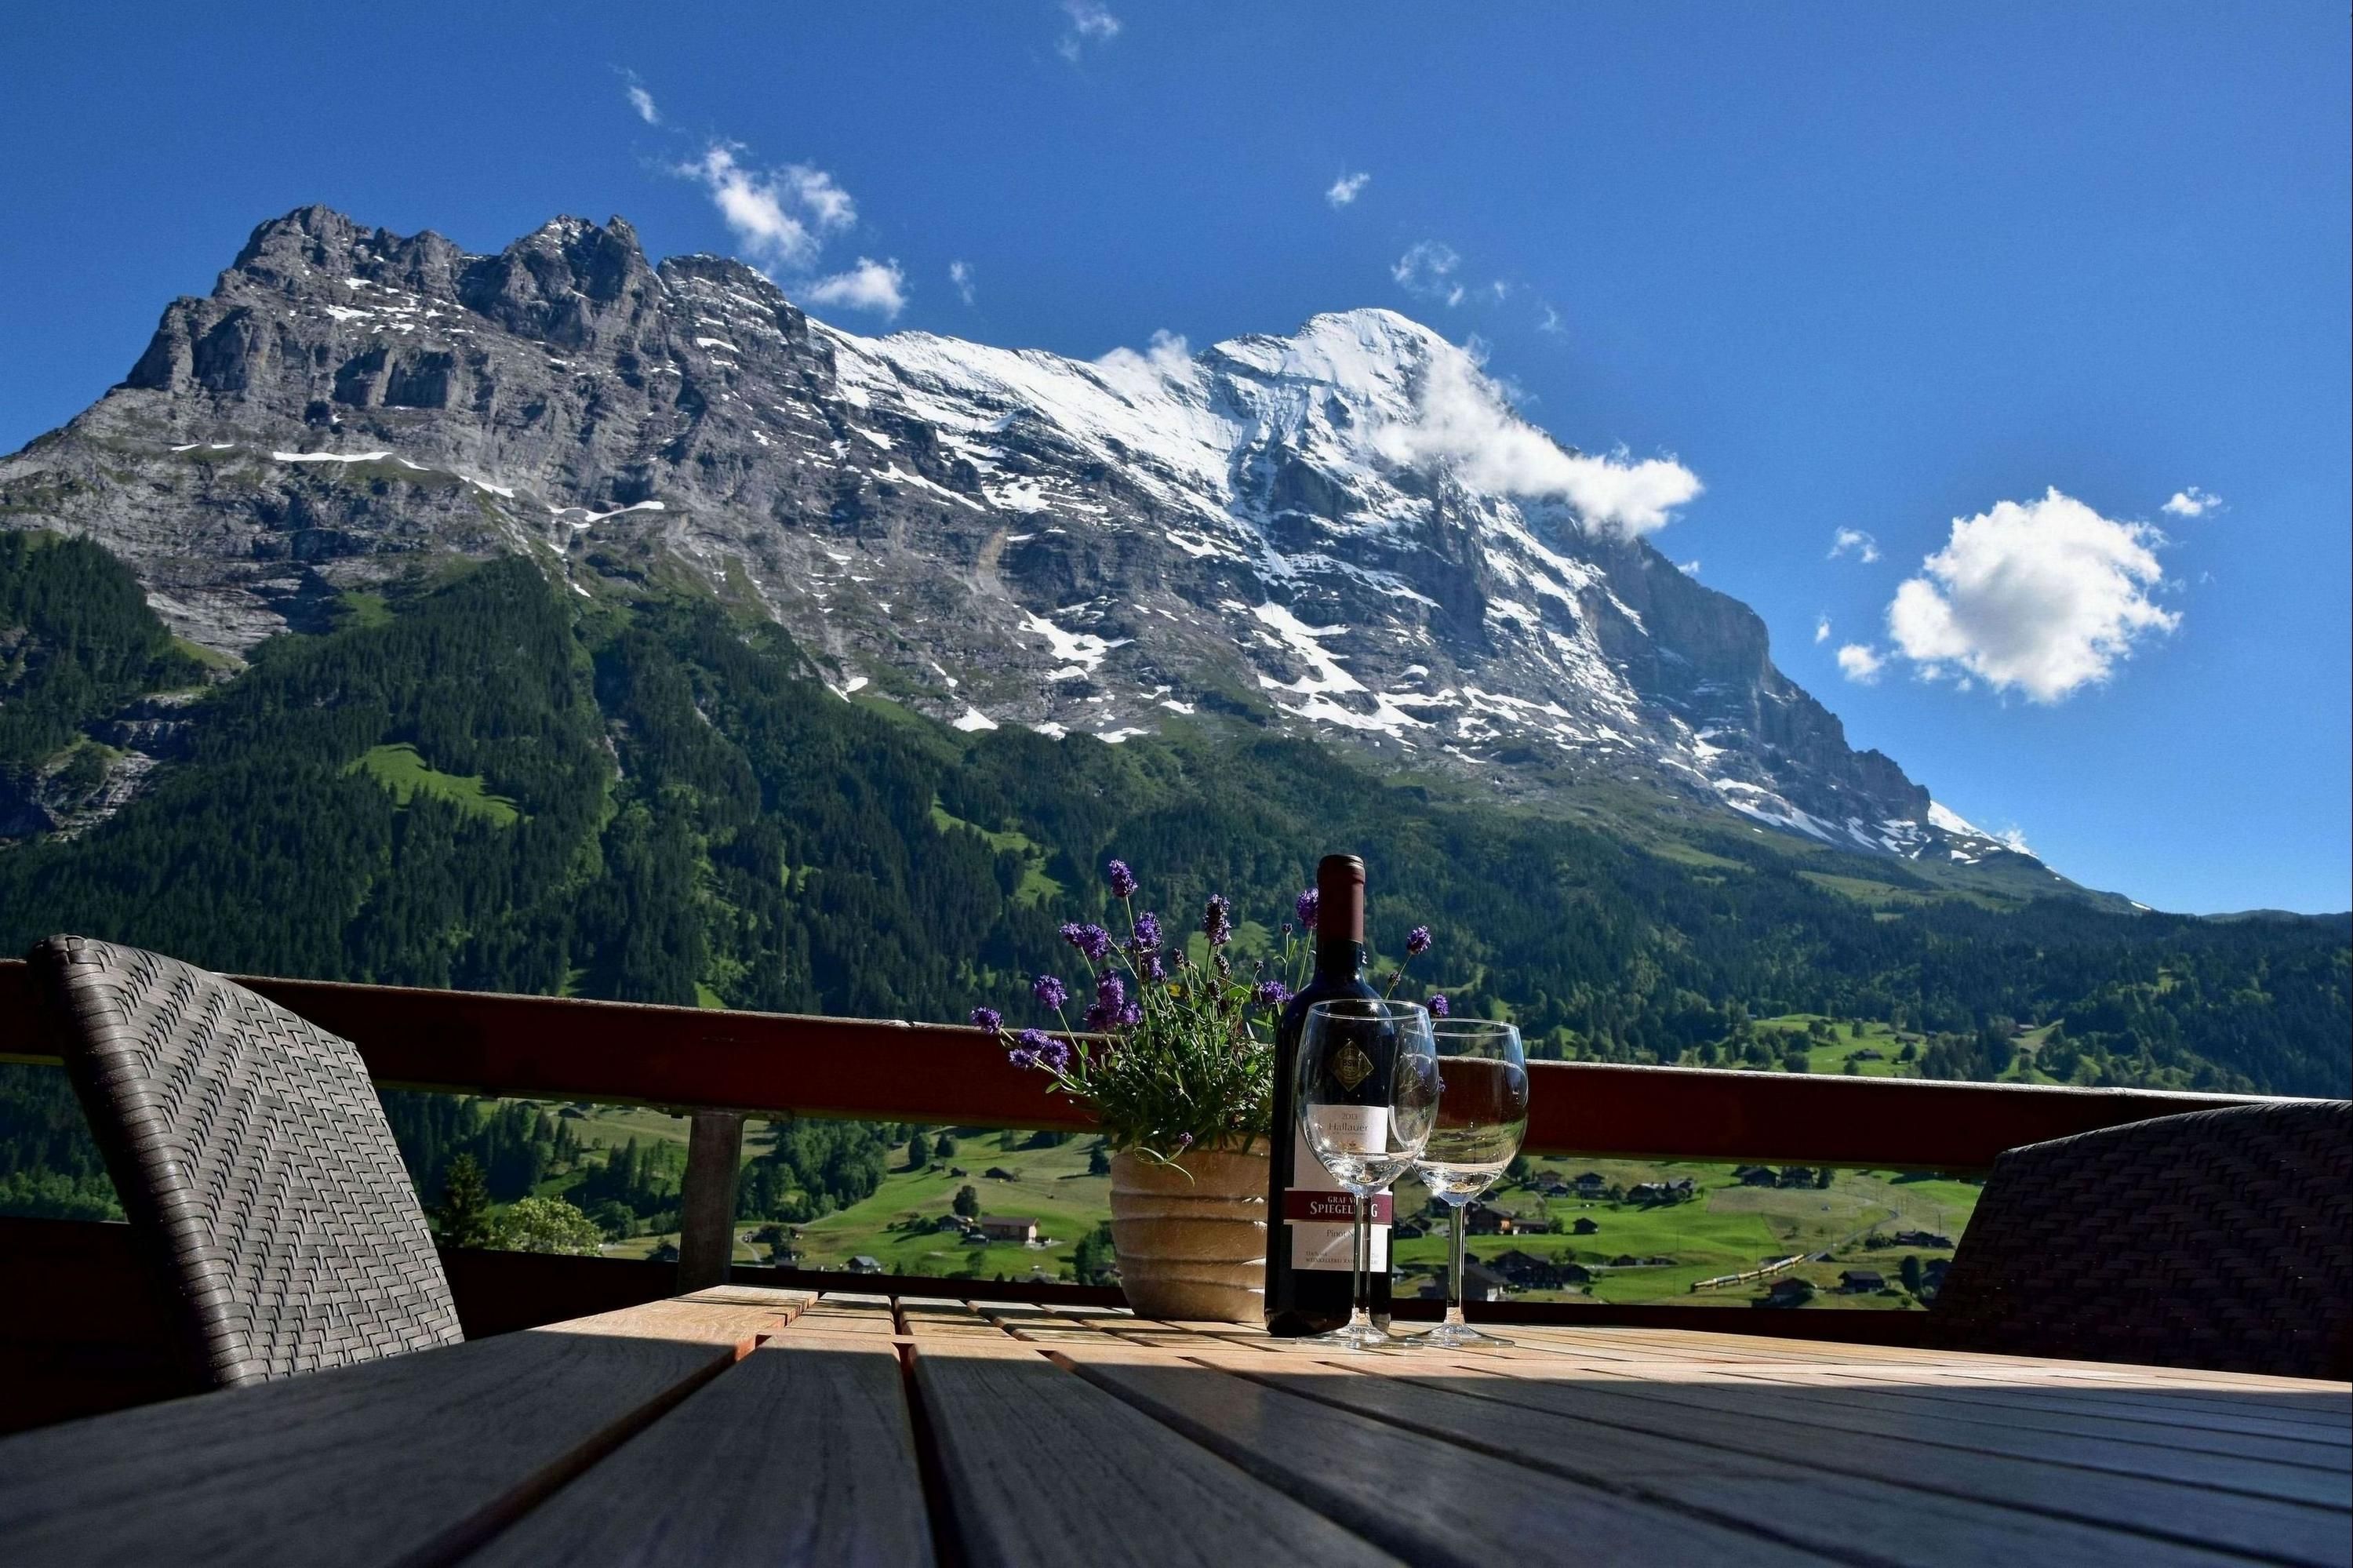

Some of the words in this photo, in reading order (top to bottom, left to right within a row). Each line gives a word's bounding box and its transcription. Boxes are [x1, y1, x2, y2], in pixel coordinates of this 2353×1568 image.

[1329, 1122, 1368, 1131] Hallauer
[1310, 1201, 1378, 1217] SPIEGELG
[1326, 1229, 1347, 1238] Pinot
